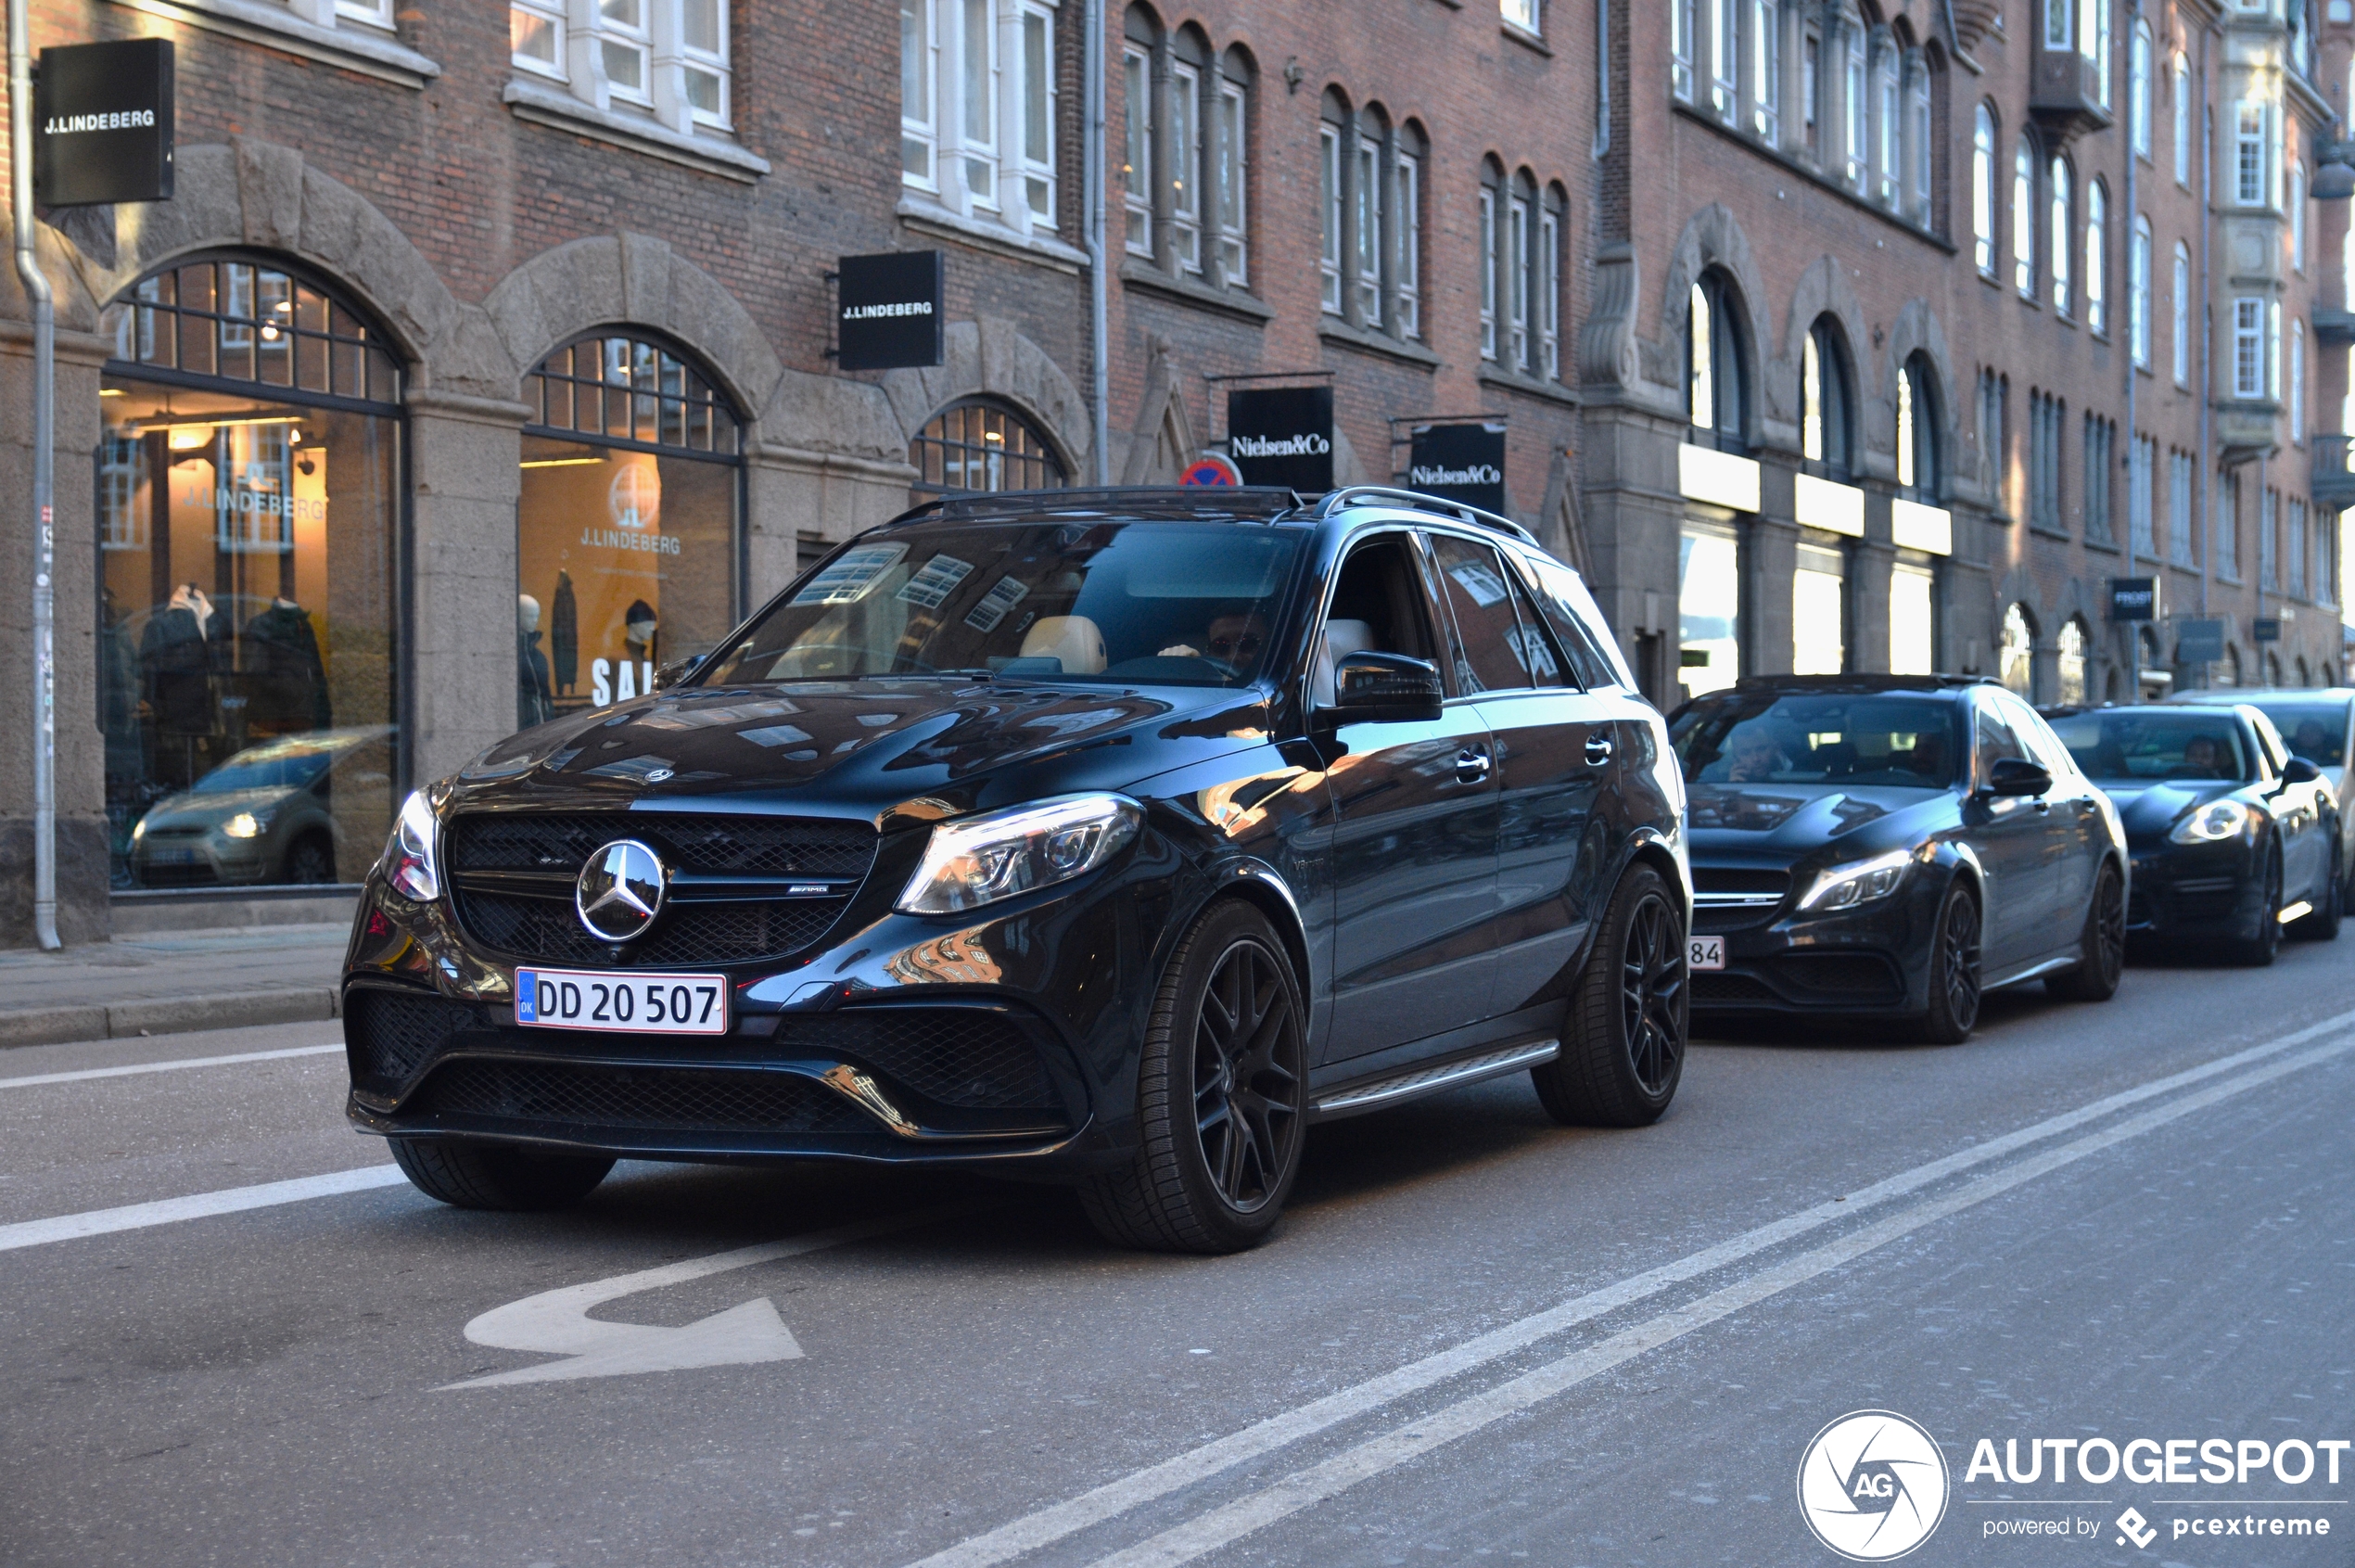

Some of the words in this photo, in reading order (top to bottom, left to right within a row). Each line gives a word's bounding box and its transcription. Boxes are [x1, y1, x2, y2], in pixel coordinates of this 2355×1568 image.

[45, 109, 155, 134] J.LINDEBERG
[843, 301, 933, 320] J.LINDEBERG
[1231, 433, 1330, 458] Nielsen&Co
[1411, 464, 1501, 486] Nielsen&Co
[183, 487, 324, 519] J.LINDEBERG
[580, 527, 681, 555] J.LINDEBERG
[1691, 942, 1720, 963] 84
[521, 1001, 533, 1013] DK
[539, 979, 581, 1019] DD
[592, 983, 634, 1022] 20
[647, 984, 718, 1024] 507
